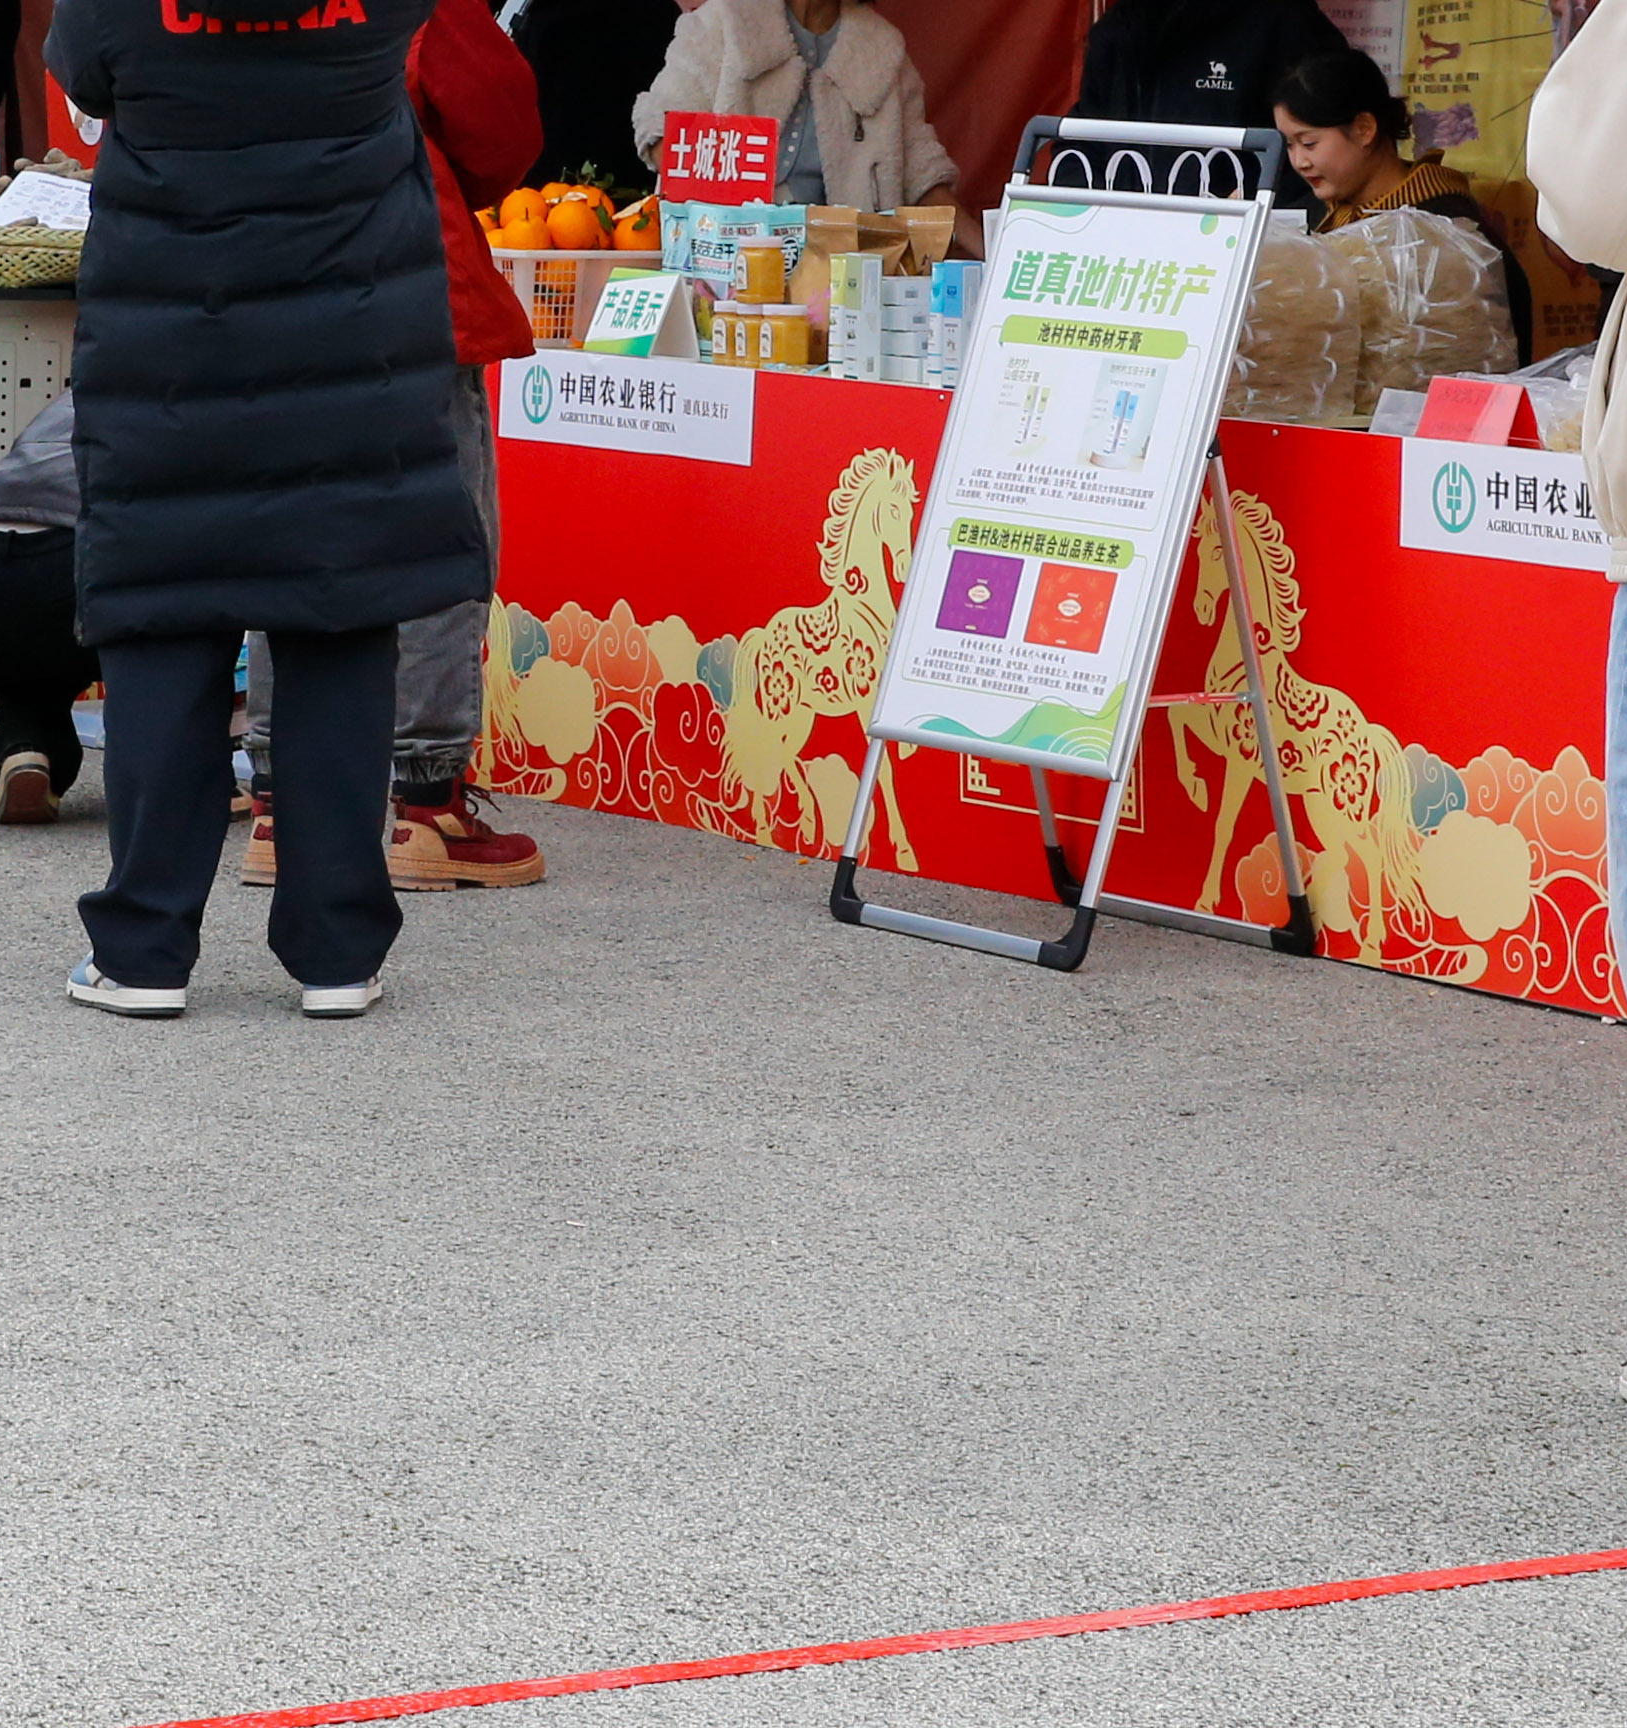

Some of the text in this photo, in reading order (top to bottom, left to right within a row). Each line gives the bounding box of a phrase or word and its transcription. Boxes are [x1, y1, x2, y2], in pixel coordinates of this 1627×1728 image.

[1195, 79, 1235, 91] CAMEL
[666, 127, 769, 182] 土城张三
[1002, 249, 1217, 317] 道真池村特产
[596, 287, 665, 332] 产品展示
[1037, 321, 1144, 353] 池村村中药材牙膏
[559, 371, 730, 420] 中国农业银行 道真县支行
[558, 411, 677, 434] AGRICULTURAL BANK OF CHINA
[956, 523, 1121, 565] 巴渔村&池村村联合出品养生茶
[1485, 518, 1569, 541] AGRICULTURAL
[1572, 528, 1603, 546] BANK
